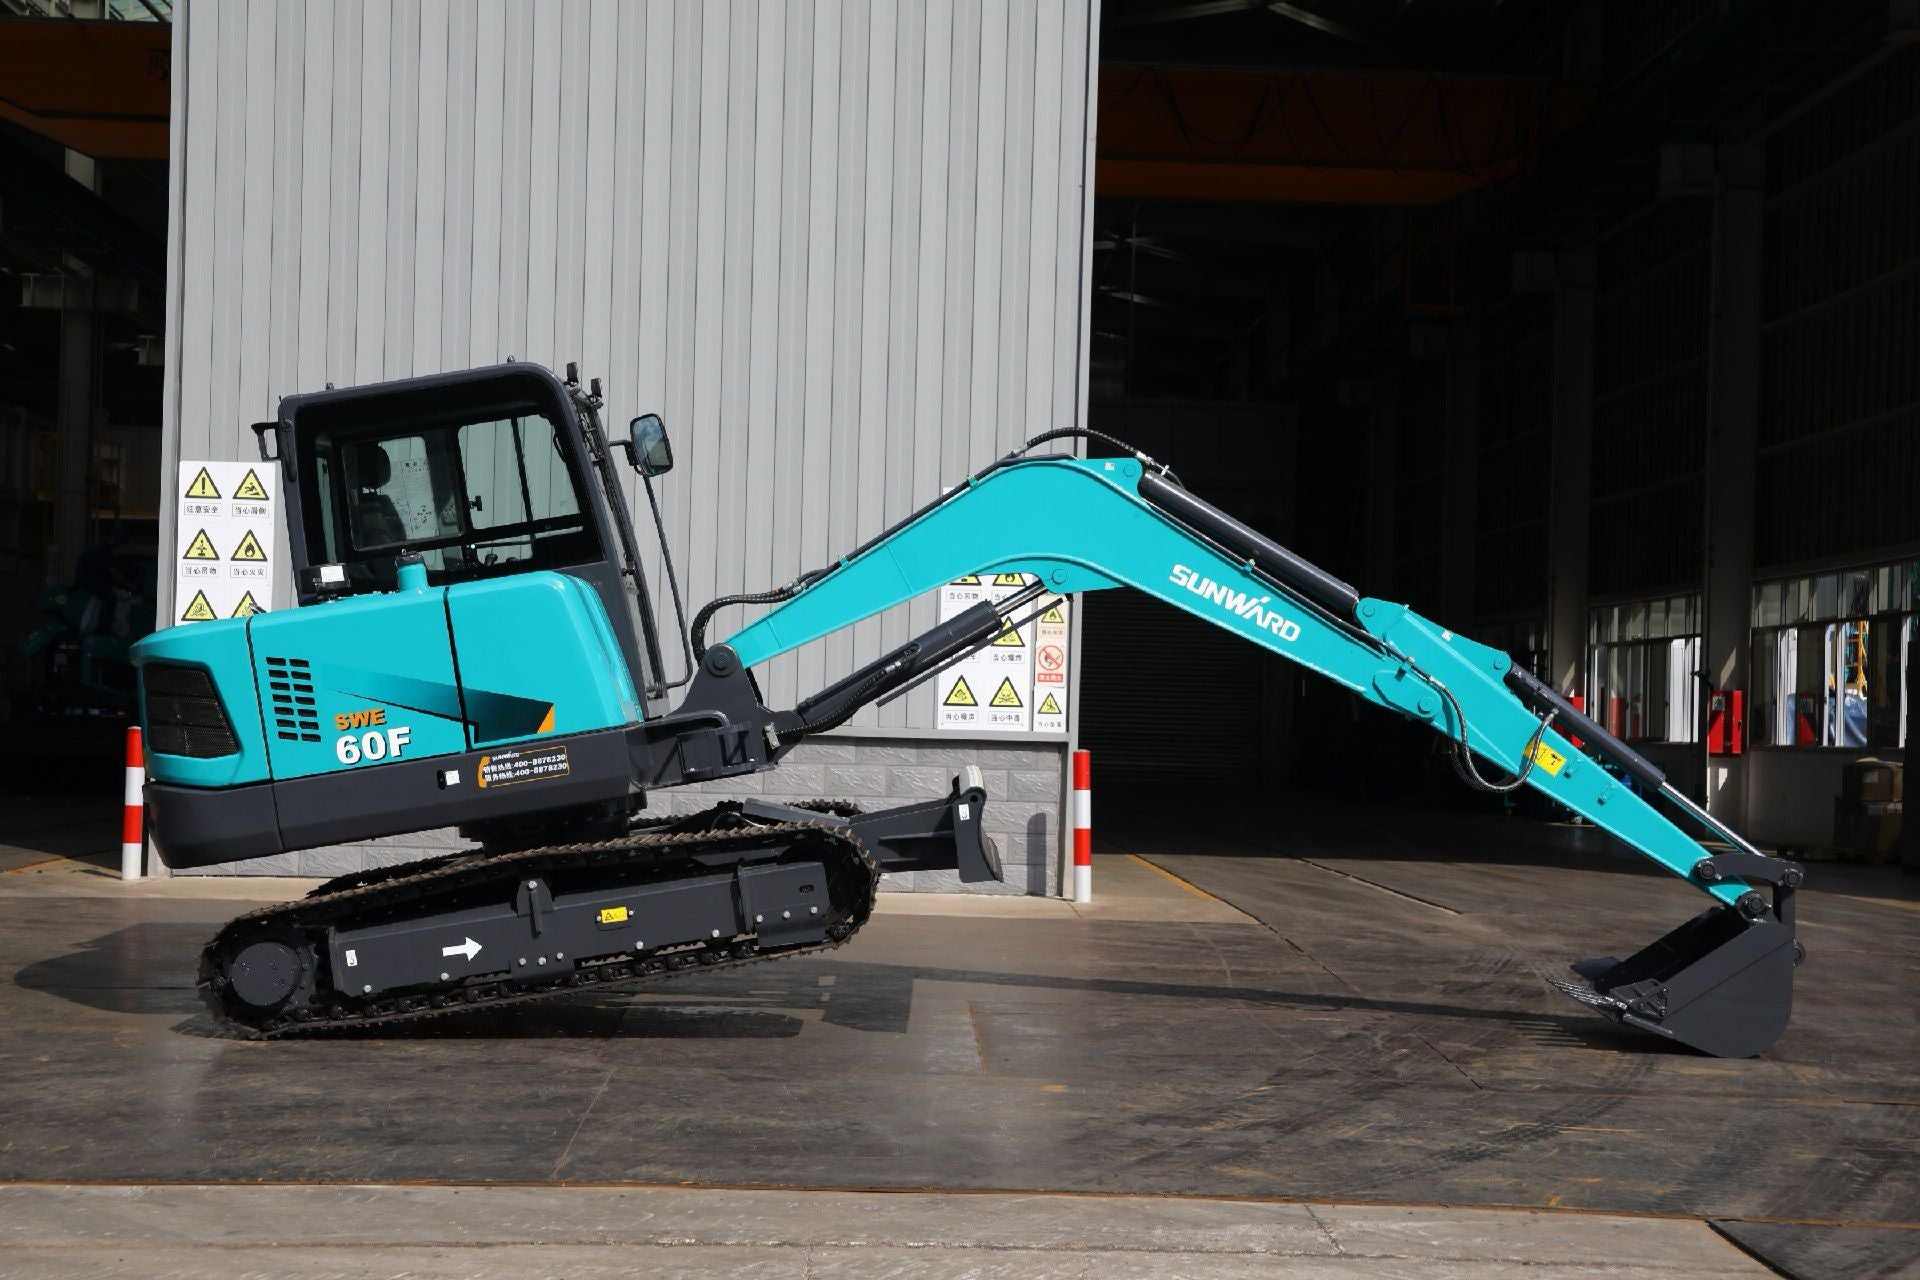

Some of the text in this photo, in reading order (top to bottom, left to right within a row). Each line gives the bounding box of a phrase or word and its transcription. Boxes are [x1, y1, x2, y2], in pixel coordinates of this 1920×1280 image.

[186, 505, 219, 514] 注意安全
[233, 568, 265, 576] 当心火灾
[1168, 563, 1301, 642] SUNWARD
[334, 708, 387, 731] SWE
[336, 726, 411, 765] 60F
